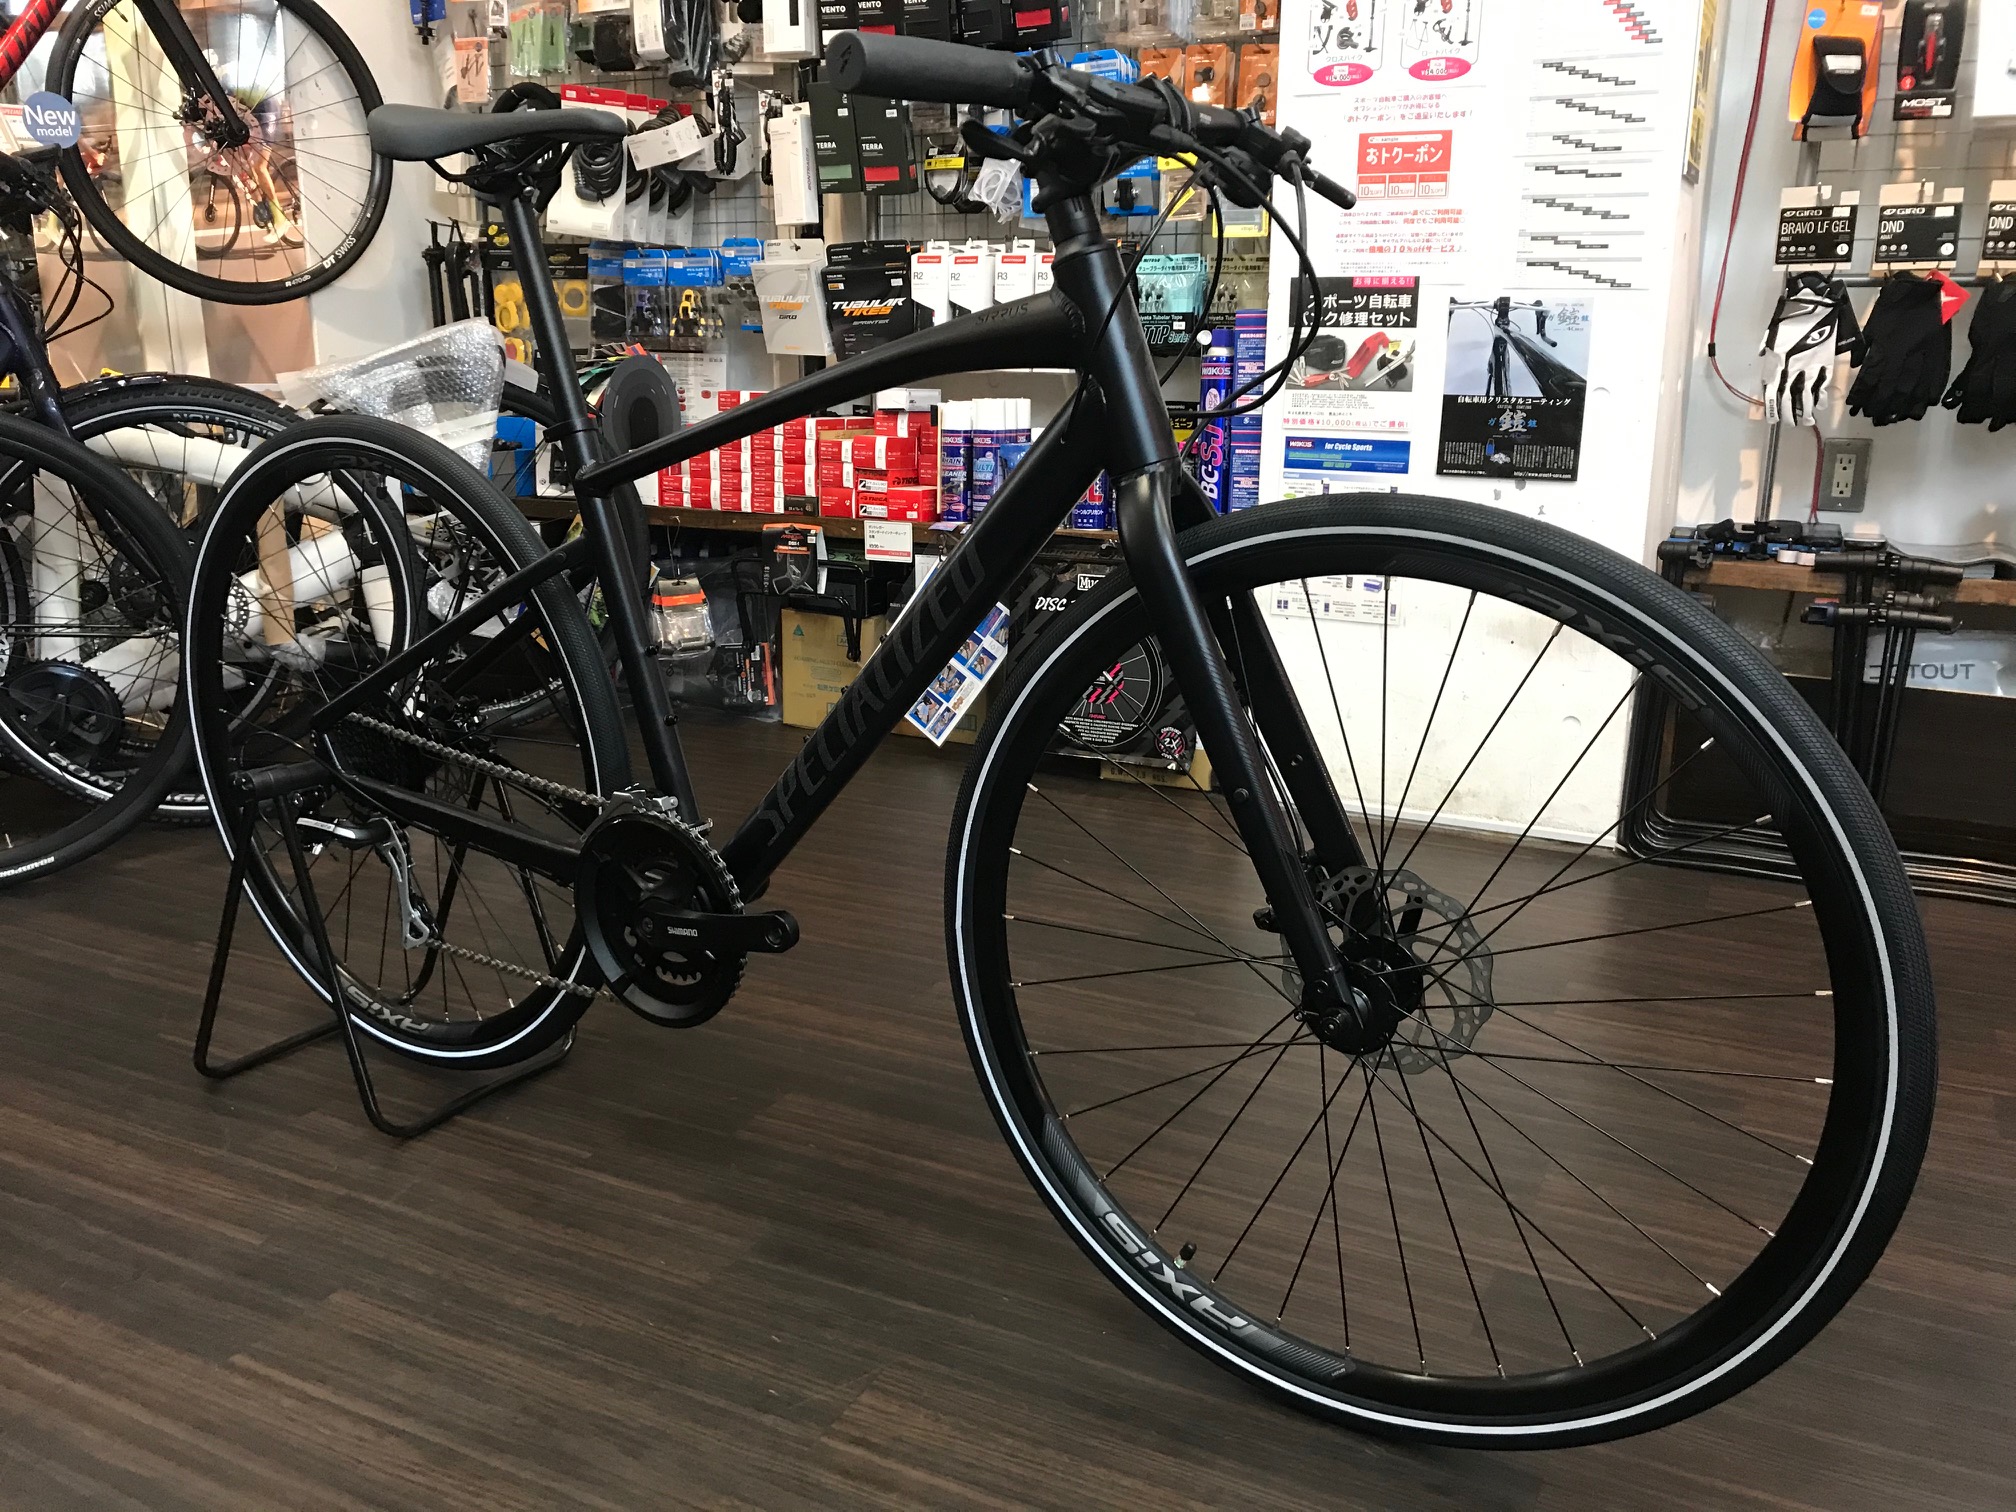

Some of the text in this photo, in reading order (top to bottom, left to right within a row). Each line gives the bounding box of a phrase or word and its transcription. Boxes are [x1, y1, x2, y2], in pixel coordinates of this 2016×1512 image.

[1902, 98, 1946, 107] MOST
[23, 105, 76, 125] New
[37, 126, 73, 136] model
[1366, 144, 1443, 165] おトクーポン
[1897, 207, 1926, 215] GIRO
[1781, 220, 1851, 234] BRAVO LF GEL
[1881, 220, 1905, 233] DND
[1988, 216, 2014, 229] DND
[323, 235, 357, 269] DT SWISS
[913, 272, 924, 280] R2
[997, 272, 1008, 280] R3
[1037, 272, 1048, 280] R3
[761, 295, 810, 303] TUBULAR
[833, 297, 907, 310] TUBULAR
[843, 306, 894, 317] TIRES
[975, 302, 1030, 325] SIRRUS
[1334, 443, 1351, 451] Cycle
[1352, 444, 1373, 452] Sports
[1034, 596, 1067, 612] DISC
[757, 544, 986, 848] SPECIALIZED
[1164, 738, 1180, 750] 2X
[667, 926, 698, 937] SHIMANO
